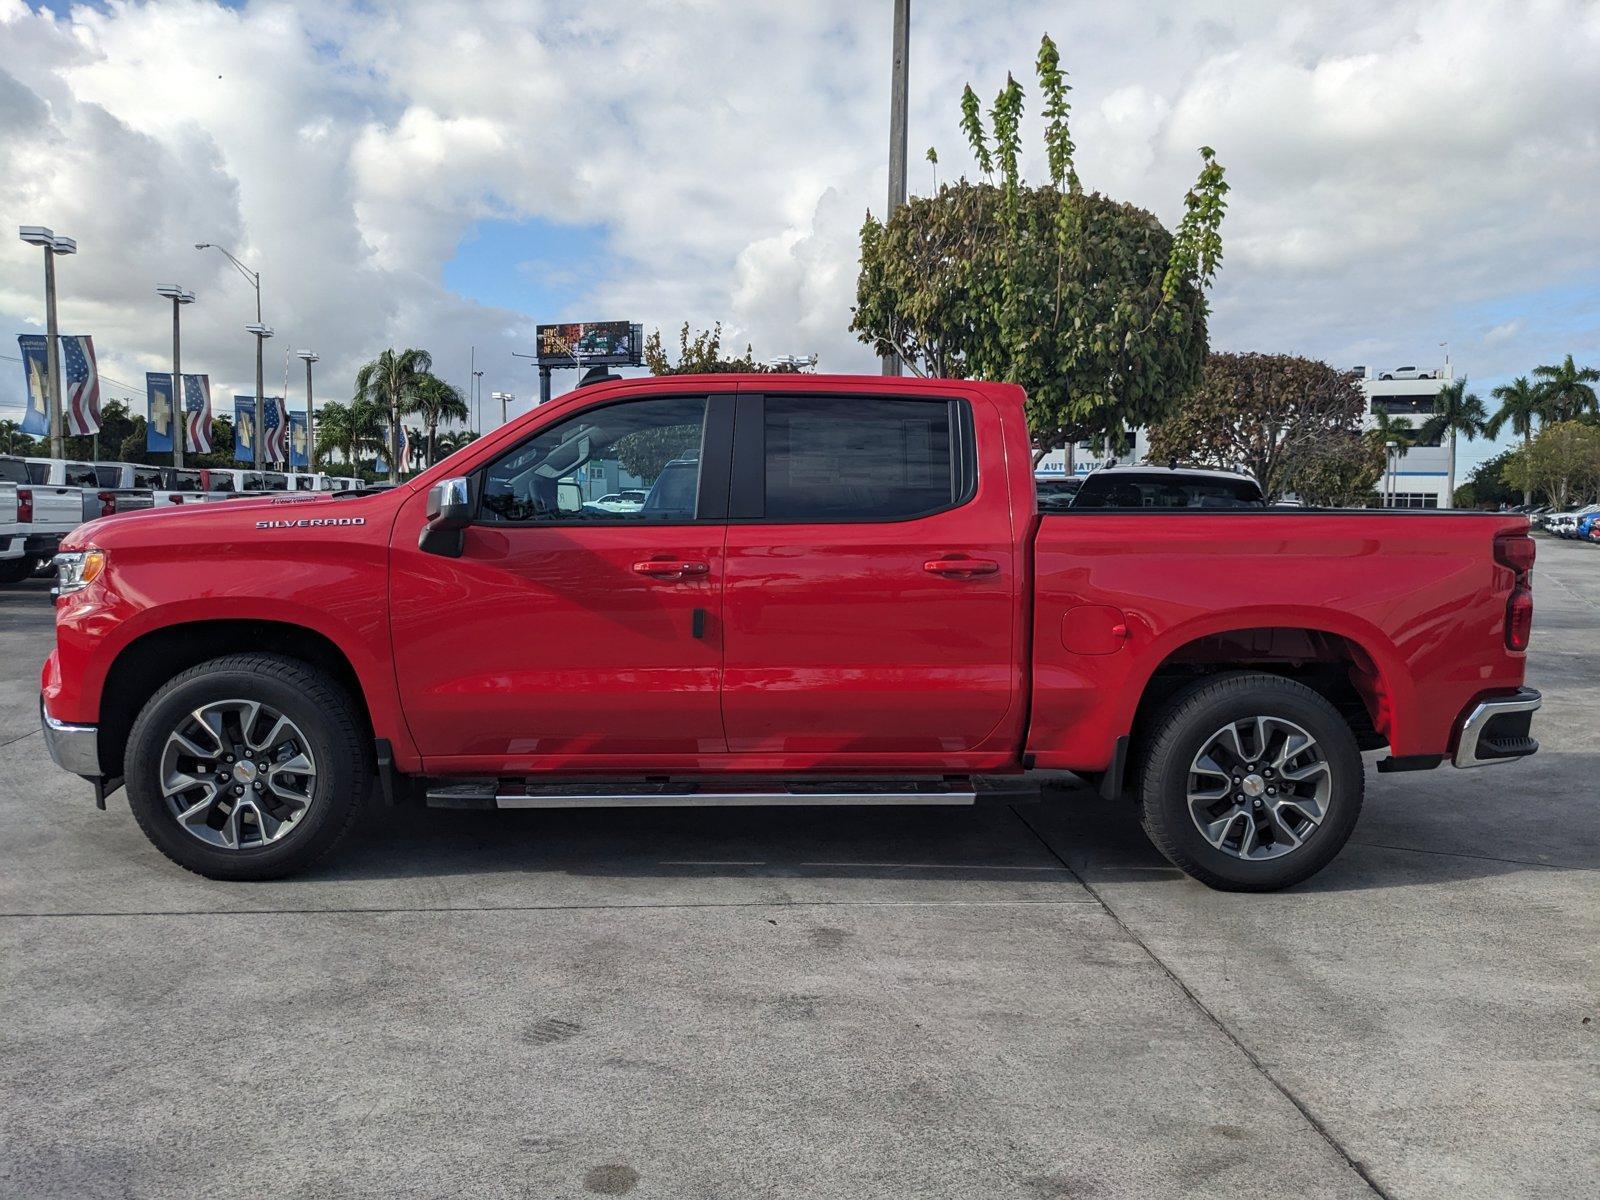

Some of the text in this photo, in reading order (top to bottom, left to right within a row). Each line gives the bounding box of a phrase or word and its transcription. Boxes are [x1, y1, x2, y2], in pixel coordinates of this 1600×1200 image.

[543, 328, 557, 337] GIVE
[543, 345, 551, 354] OF
[255, 517, 365, 529] SILVERADO
